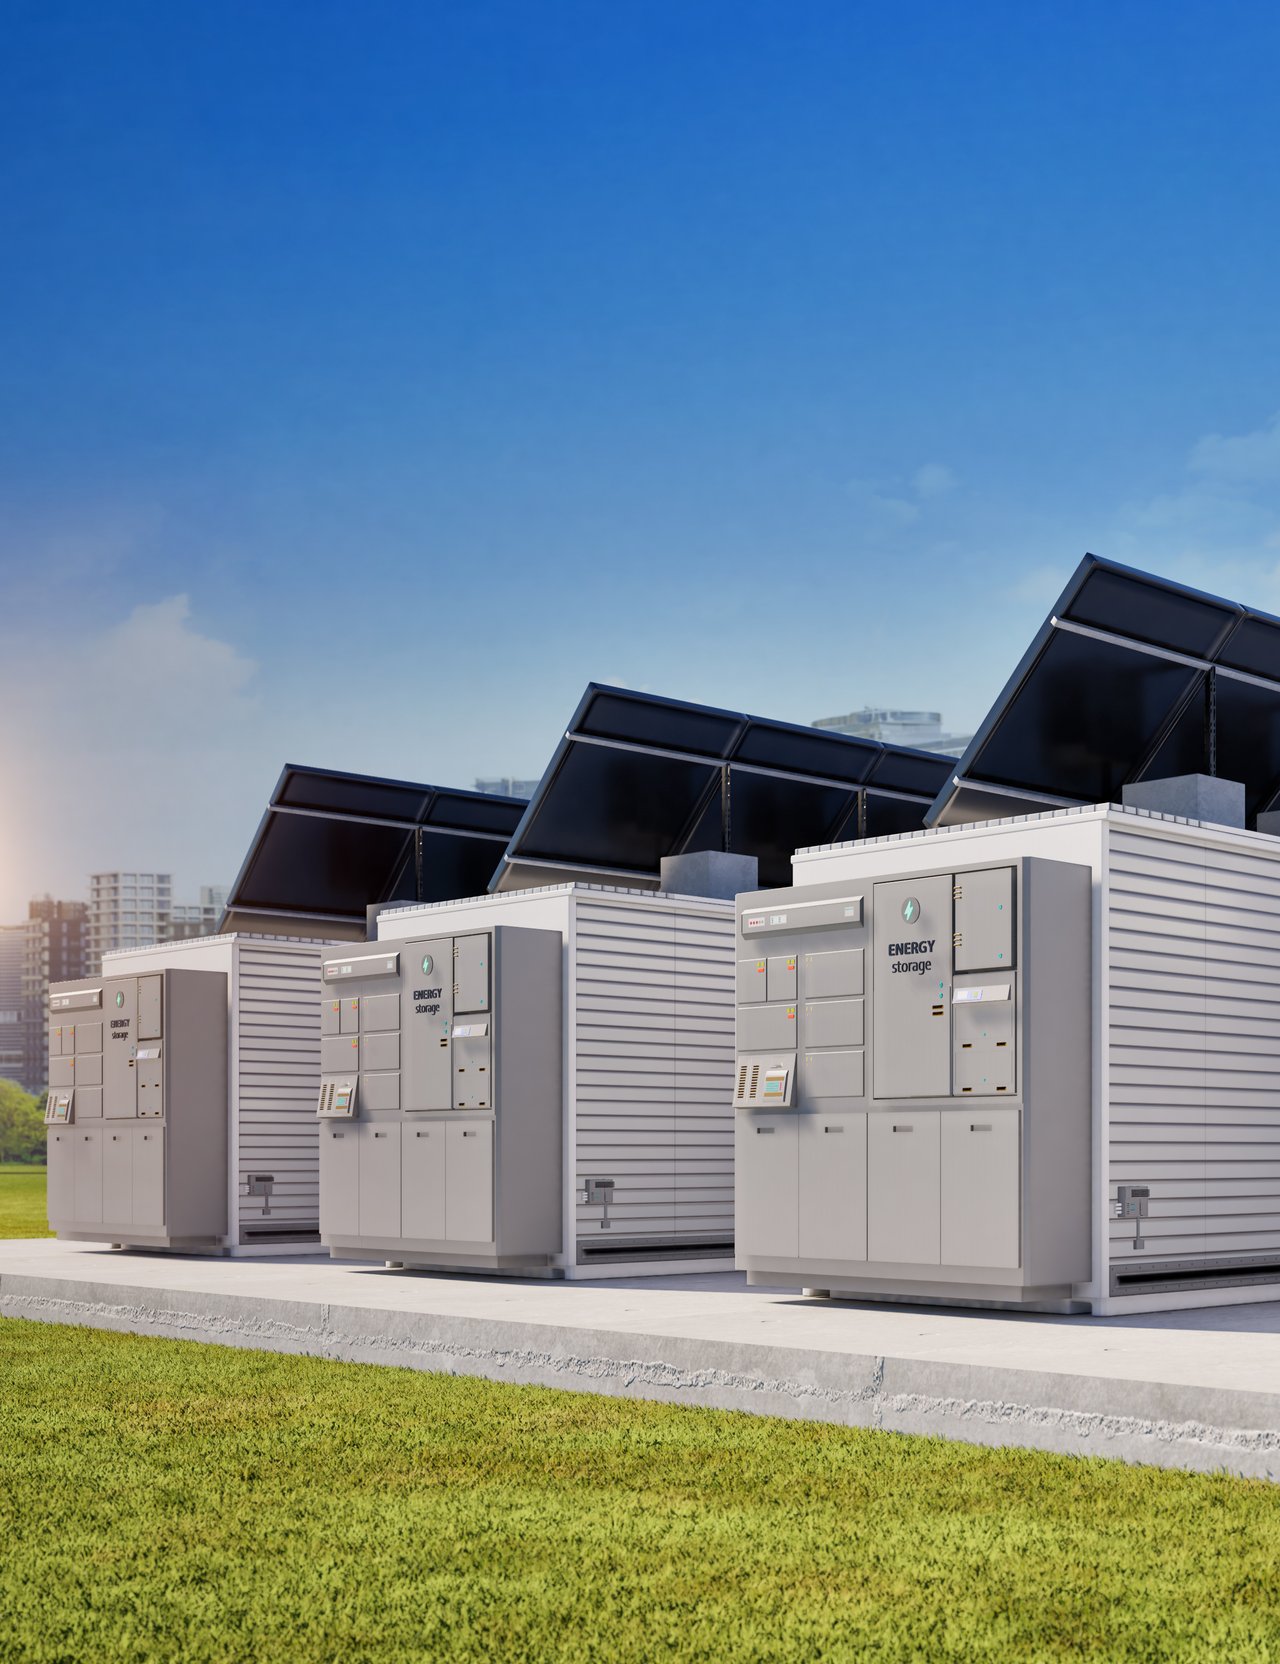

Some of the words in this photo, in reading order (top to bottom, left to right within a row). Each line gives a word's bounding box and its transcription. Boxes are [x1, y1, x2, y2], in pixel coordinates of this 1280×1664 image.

[888, 939, 936, 957] ENERGY
[891, 961, 932, 975] storage
[413, 987, 443, 1001] ENERGY
[415, 1003, 441, 1016] storage
